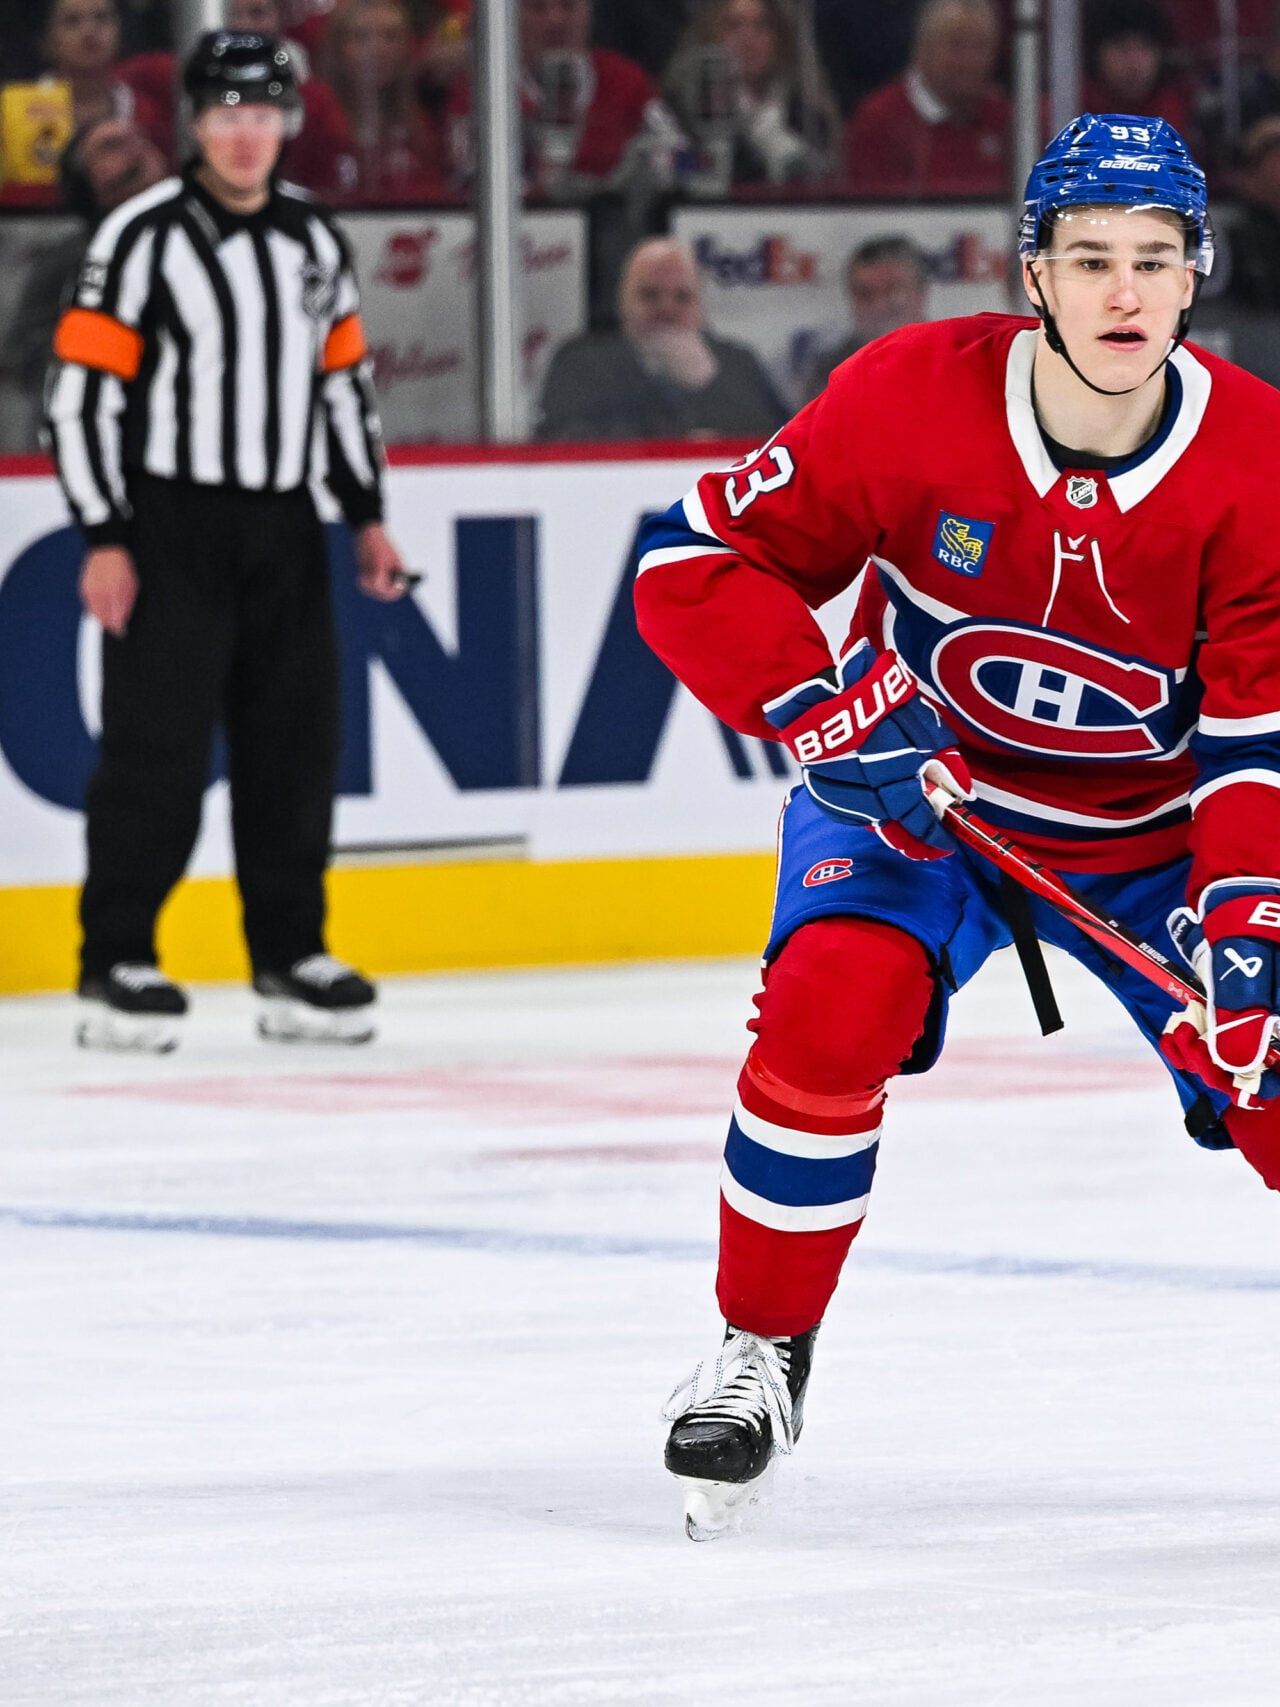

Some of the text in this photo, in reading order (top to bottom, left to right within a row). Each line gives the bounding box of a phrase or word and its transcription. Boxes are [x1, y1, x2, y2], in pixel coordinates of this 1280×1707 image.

[1110, 126, 1151, 142] 93
[715, 425, 795, 518] 3
[938, 548, 976, 573] RBC
